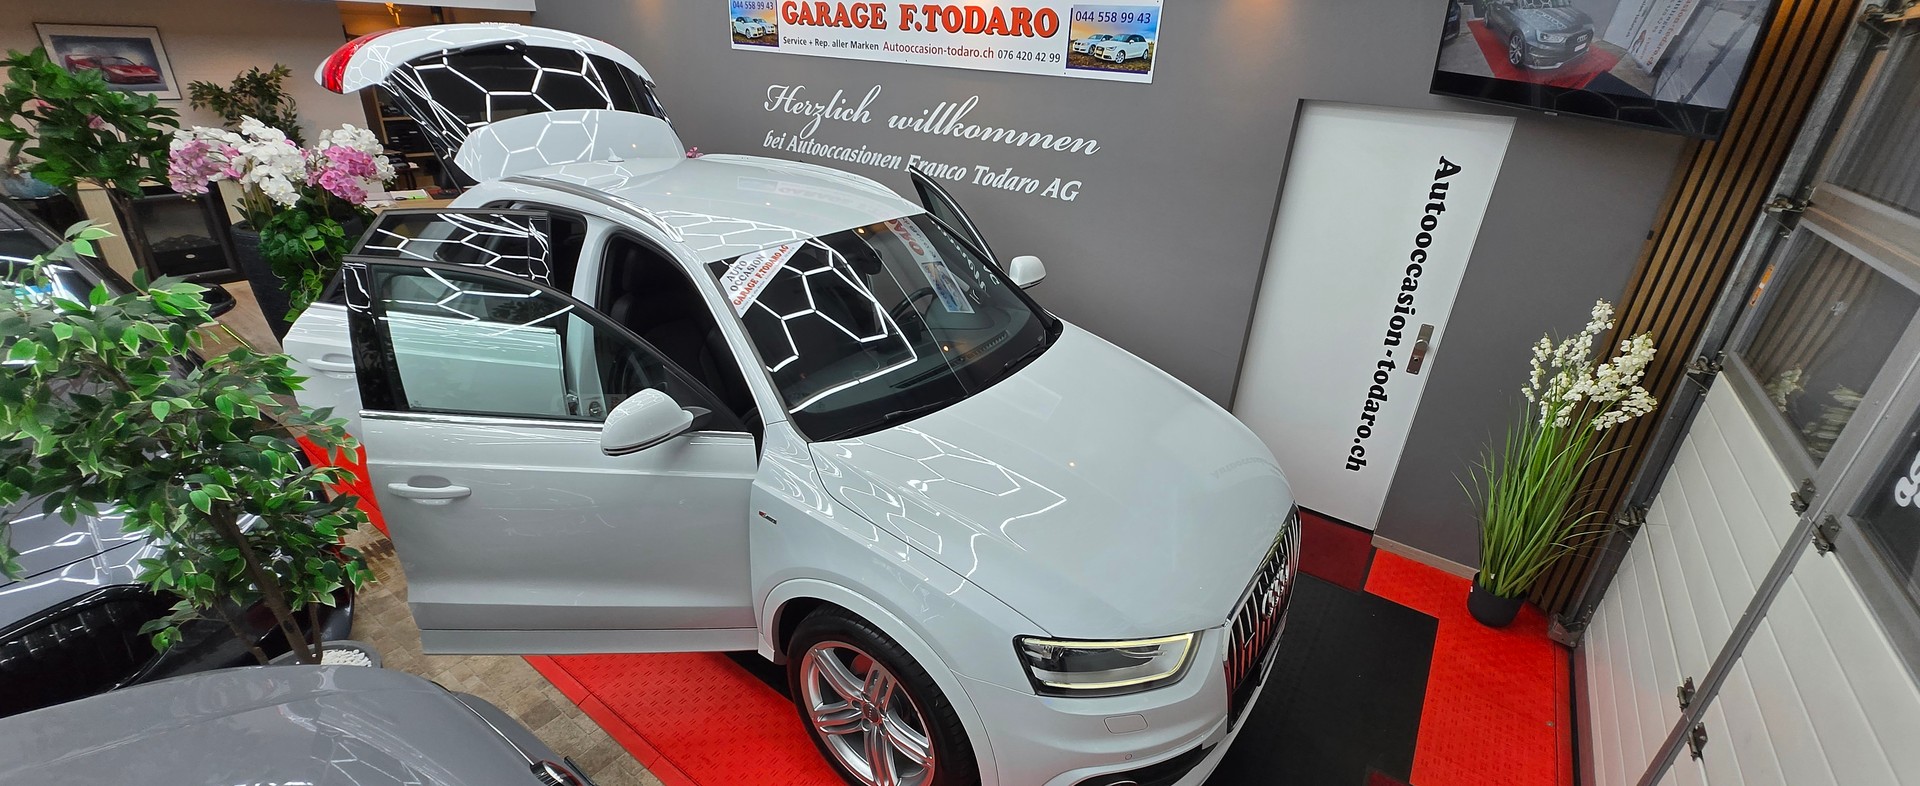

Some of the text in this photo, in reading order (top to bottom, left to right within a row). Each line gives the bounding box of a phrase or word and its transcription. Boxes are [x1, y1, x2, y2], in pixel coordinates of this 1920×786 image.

[733, 0, 774, 10] 044 558 99 43
[781, 0, 1060, 38] GARAGE F.TODARO
[1075, 11, 1151, 24] 044 558 99 43
[783, 36, 807, 46] Service
[815, 38, 830, 49] Rep.
[832, 39, 848, 48] aller
[851, 40, 879, 51] Marken
[883, 41, 994, 59] Autooccasion-todaro.ch
[997, 50, 1013, 60] 076
[1016, 51, 1032, 61] 420
[1035, 52, 1046, 62] 42
[1049, 53, 1061, 63] 99
[763, 84, 1100, 155] Herzlich willkommen
[763, 129, 1082, 202] bei Autooccasionen Franco Todaro AG
[727, 260, 747, 282] AUTO
[730, 254, 766, 292] OCCASION
[733, 278, 759, 306] GARAGE
[755, 252, 782, 279] F.TODARO
[1345, 155, 1462, 472] Autooccasion-todaro.ch
